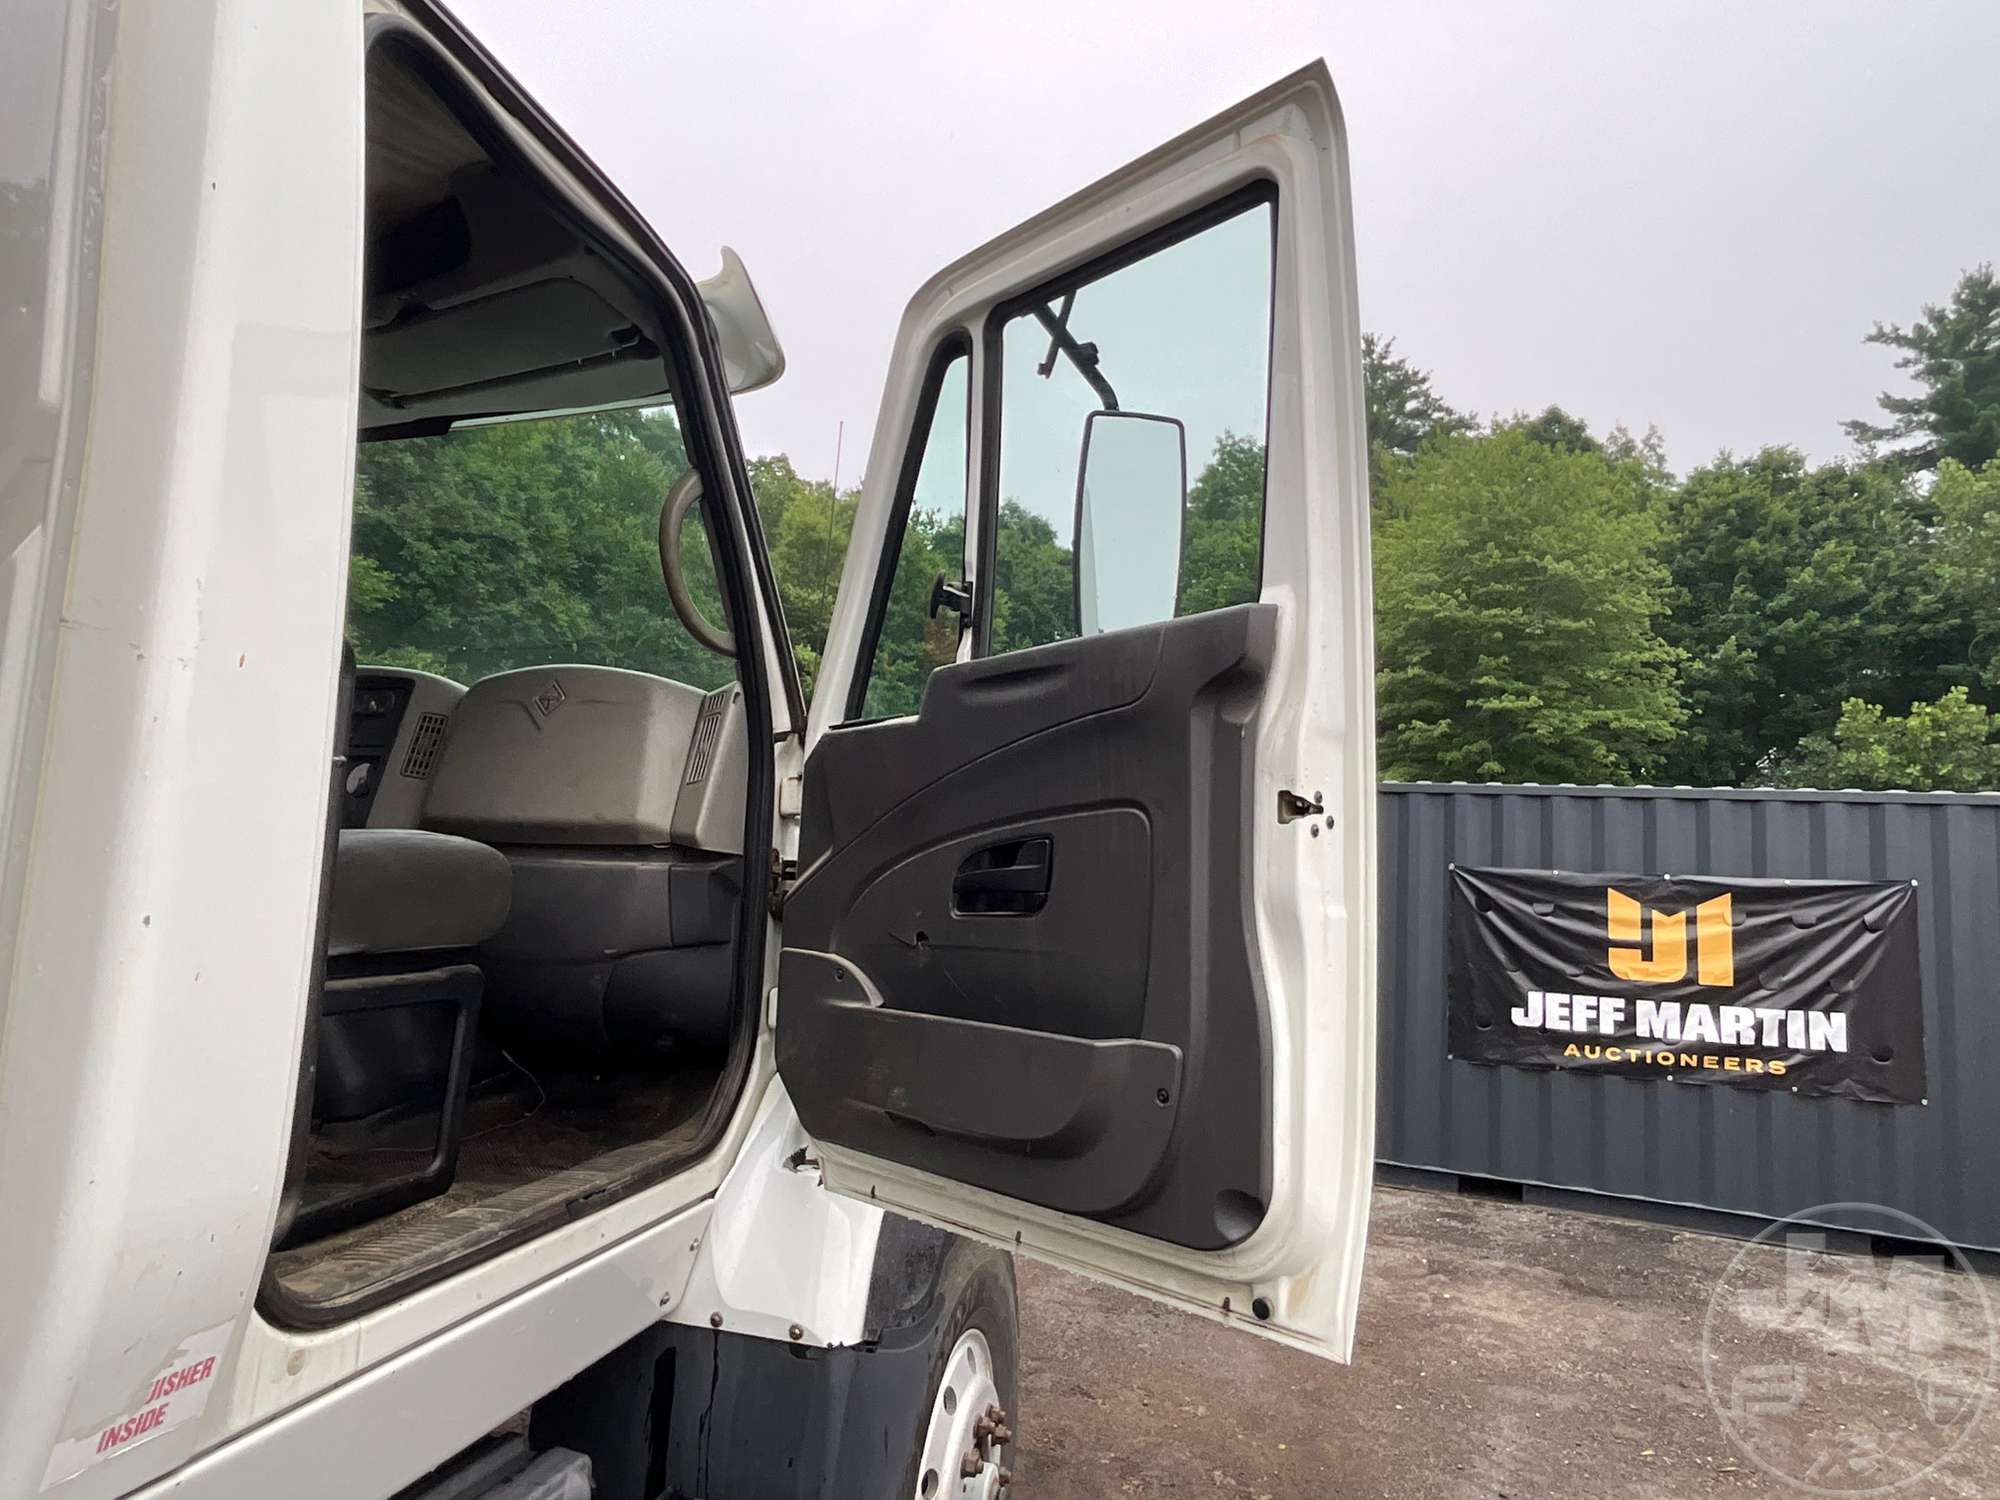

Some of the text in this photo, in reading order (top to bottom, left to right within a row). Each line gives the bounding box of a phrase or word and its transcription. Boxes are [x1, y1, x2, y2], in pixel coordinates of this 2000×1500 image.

[1511, 990, 1848, 1053] JEFF MARTIN
[1563, 1043, 1788, 1076] AUCTIONEERS
[96, 1402, 170, 1454] INSIDE
